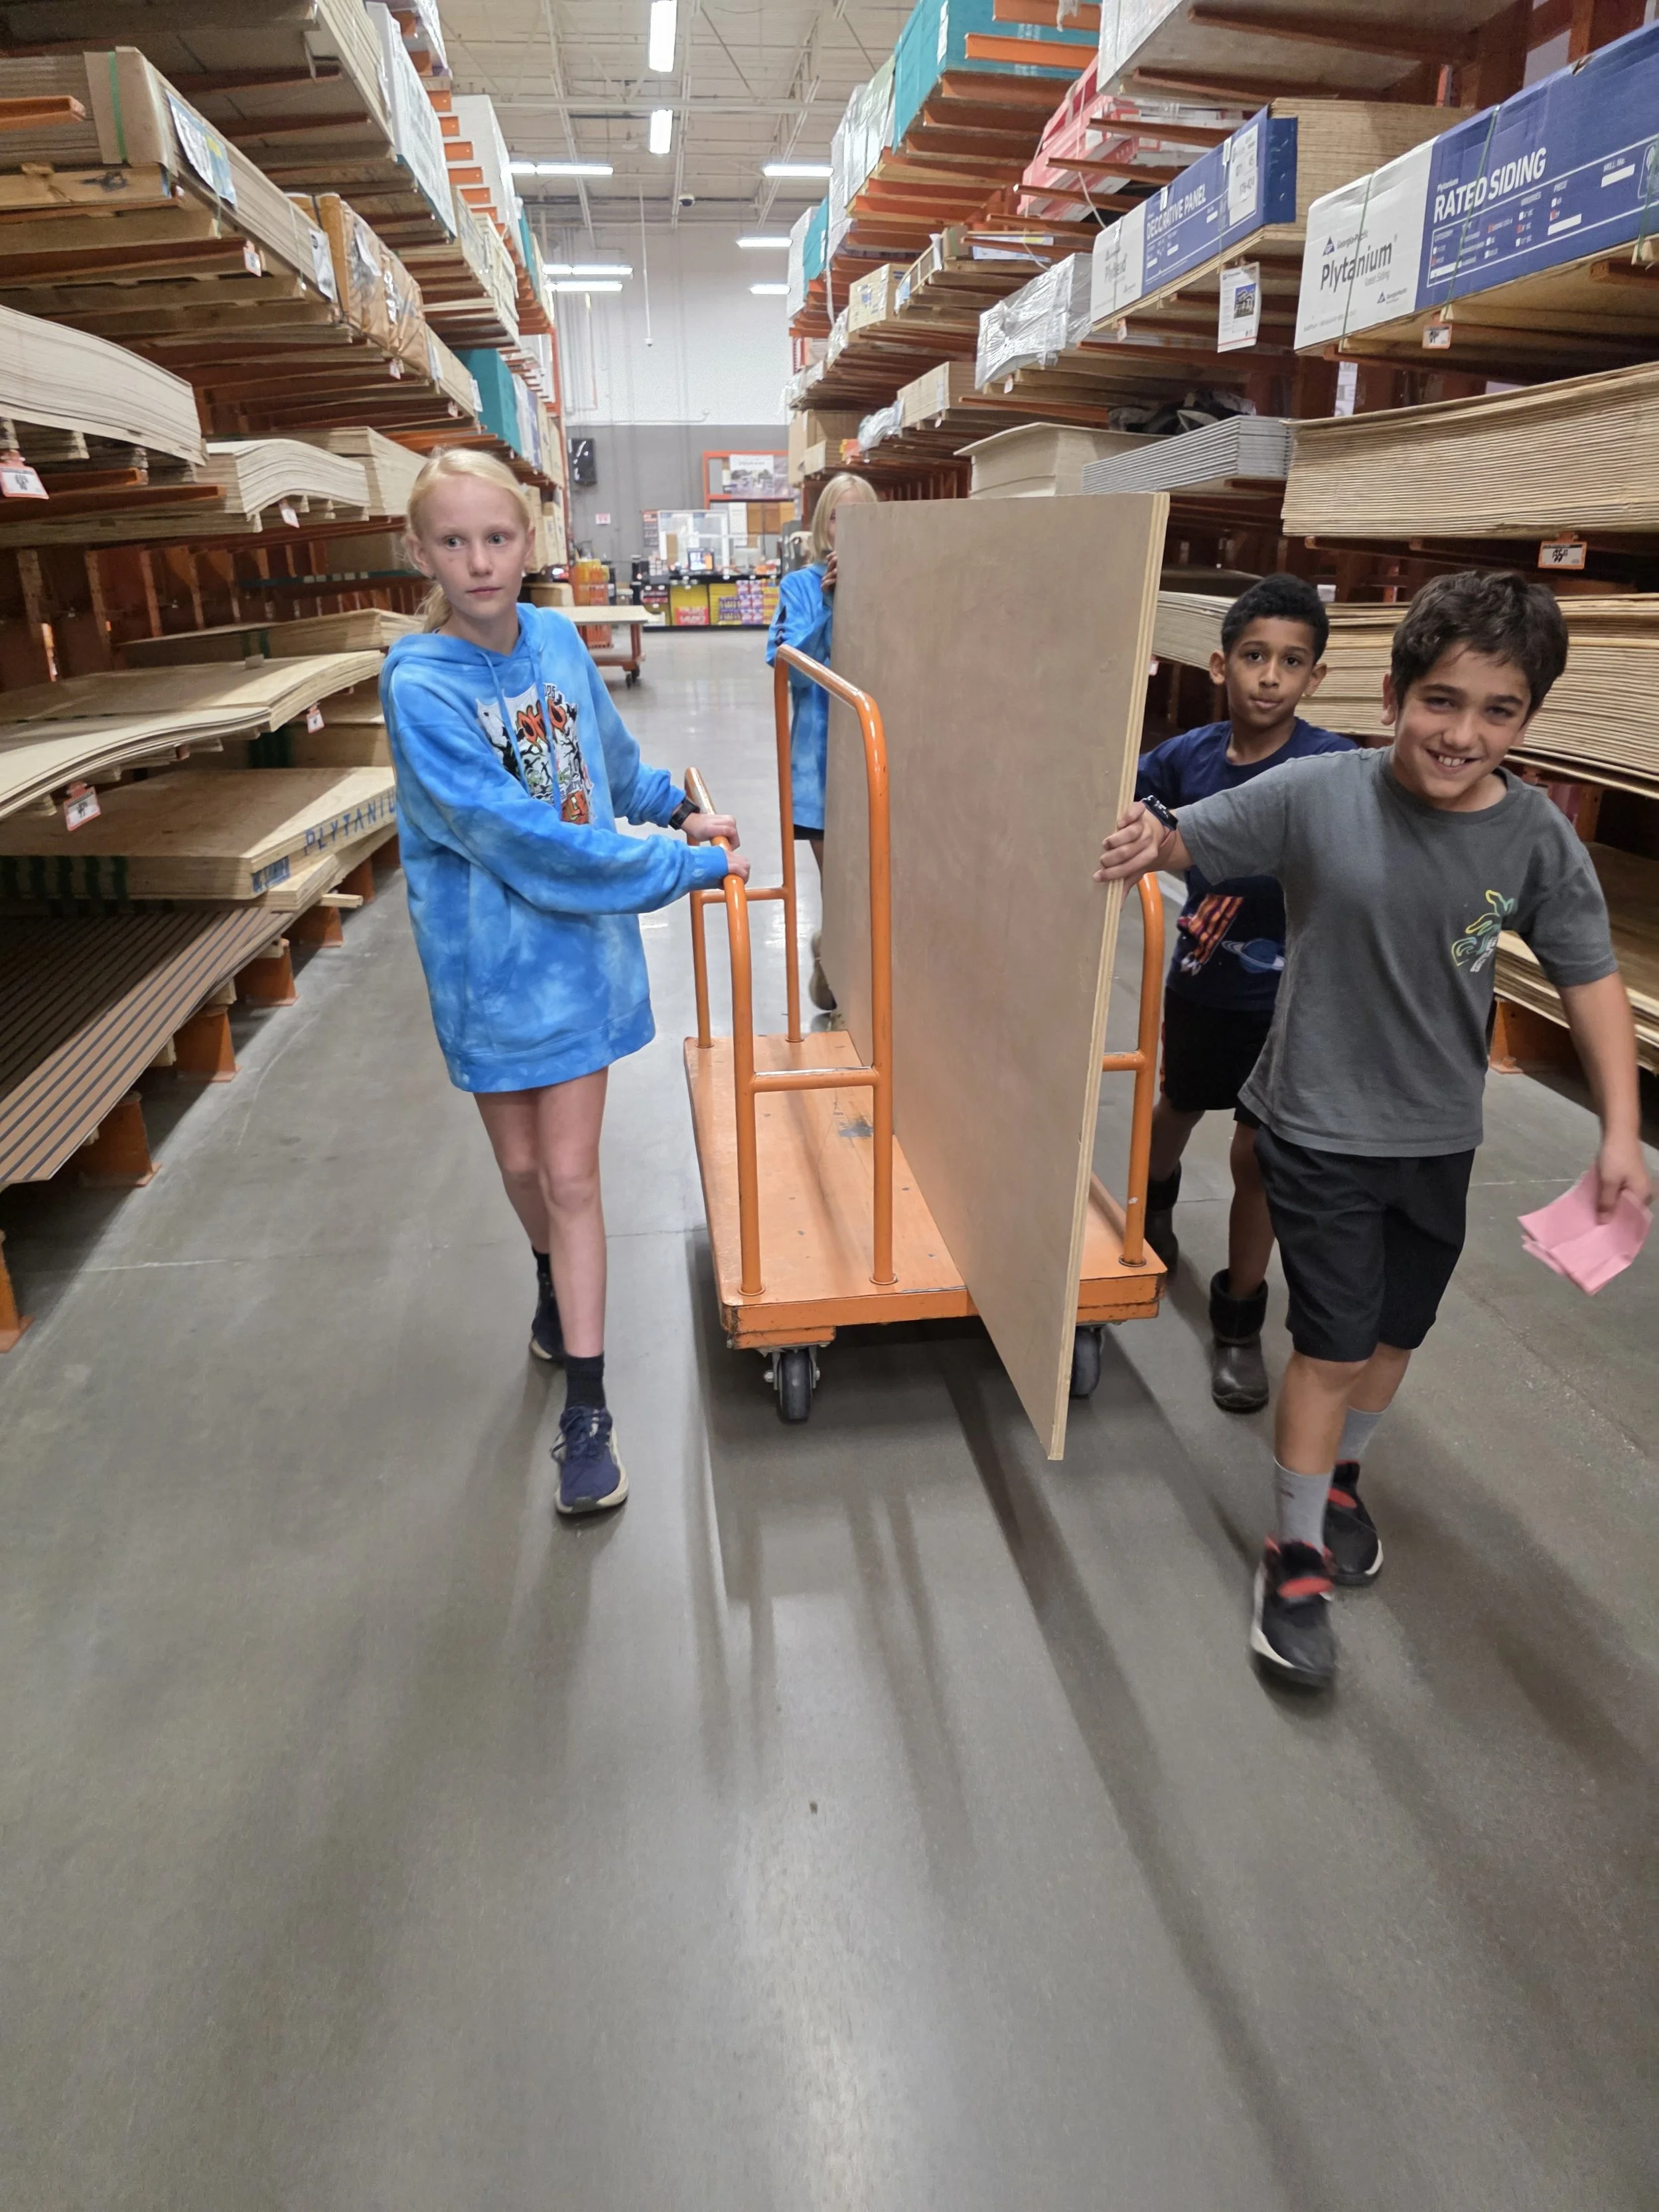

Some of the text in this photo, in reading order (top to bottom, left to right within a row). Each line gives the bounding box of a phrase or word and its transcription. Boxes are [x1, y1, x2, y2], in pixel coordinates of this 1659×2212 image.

[1184, 184, 1206, 216] PANEL
[1433, 147, 1547, 224] RATED SIDING
[1319, 242, 1393, 293] Plytanium
